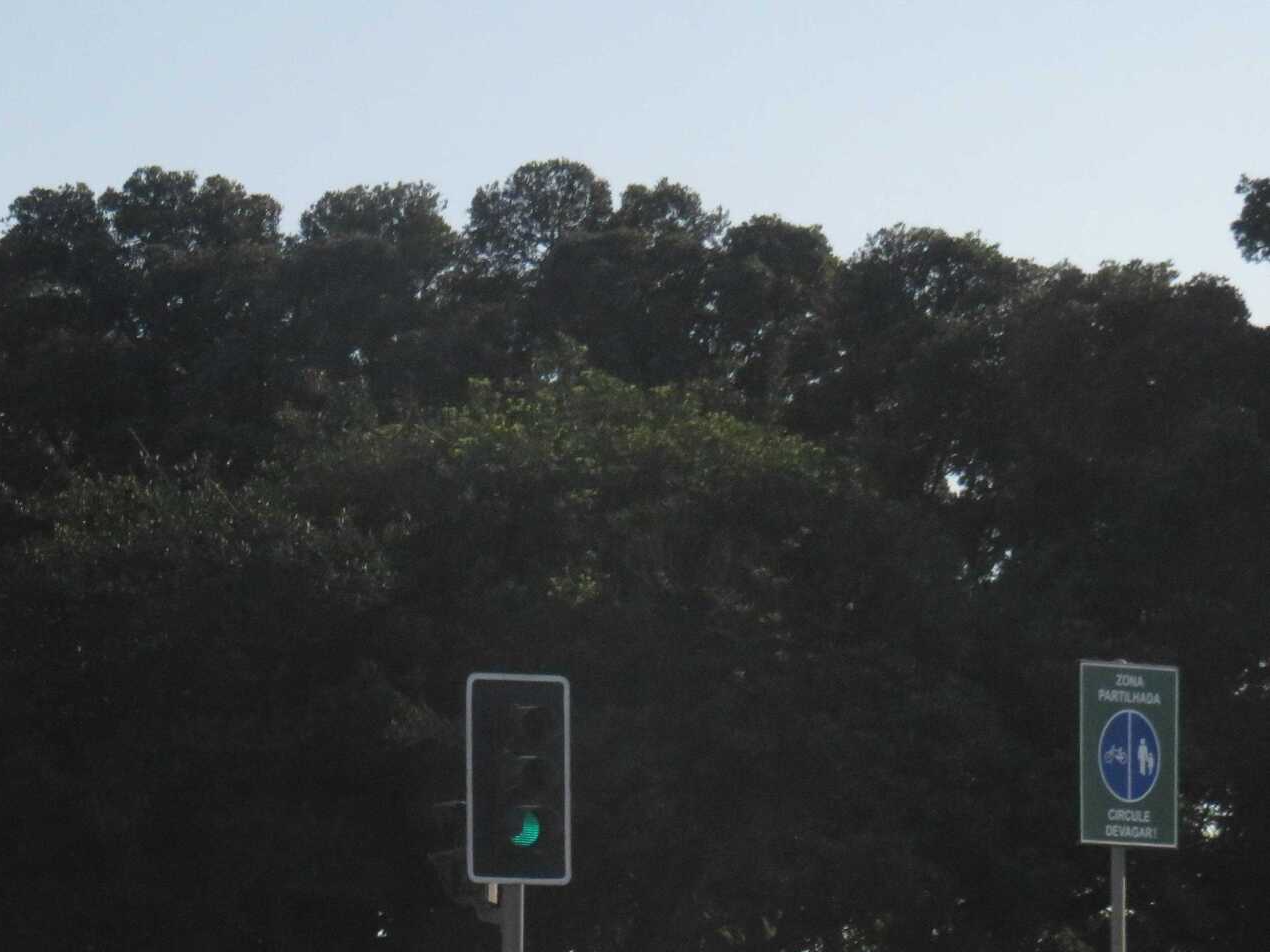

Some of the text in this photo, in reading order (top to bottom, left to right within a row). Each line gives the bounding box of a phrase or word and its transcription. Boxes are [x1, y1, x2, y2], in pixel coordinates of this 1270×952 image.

[1116, 674, 1144, 688] ZONA
[1098, 689, 1161, 705] PARTILHADA
[1107, 809, 1151, 823] CIRCULE
